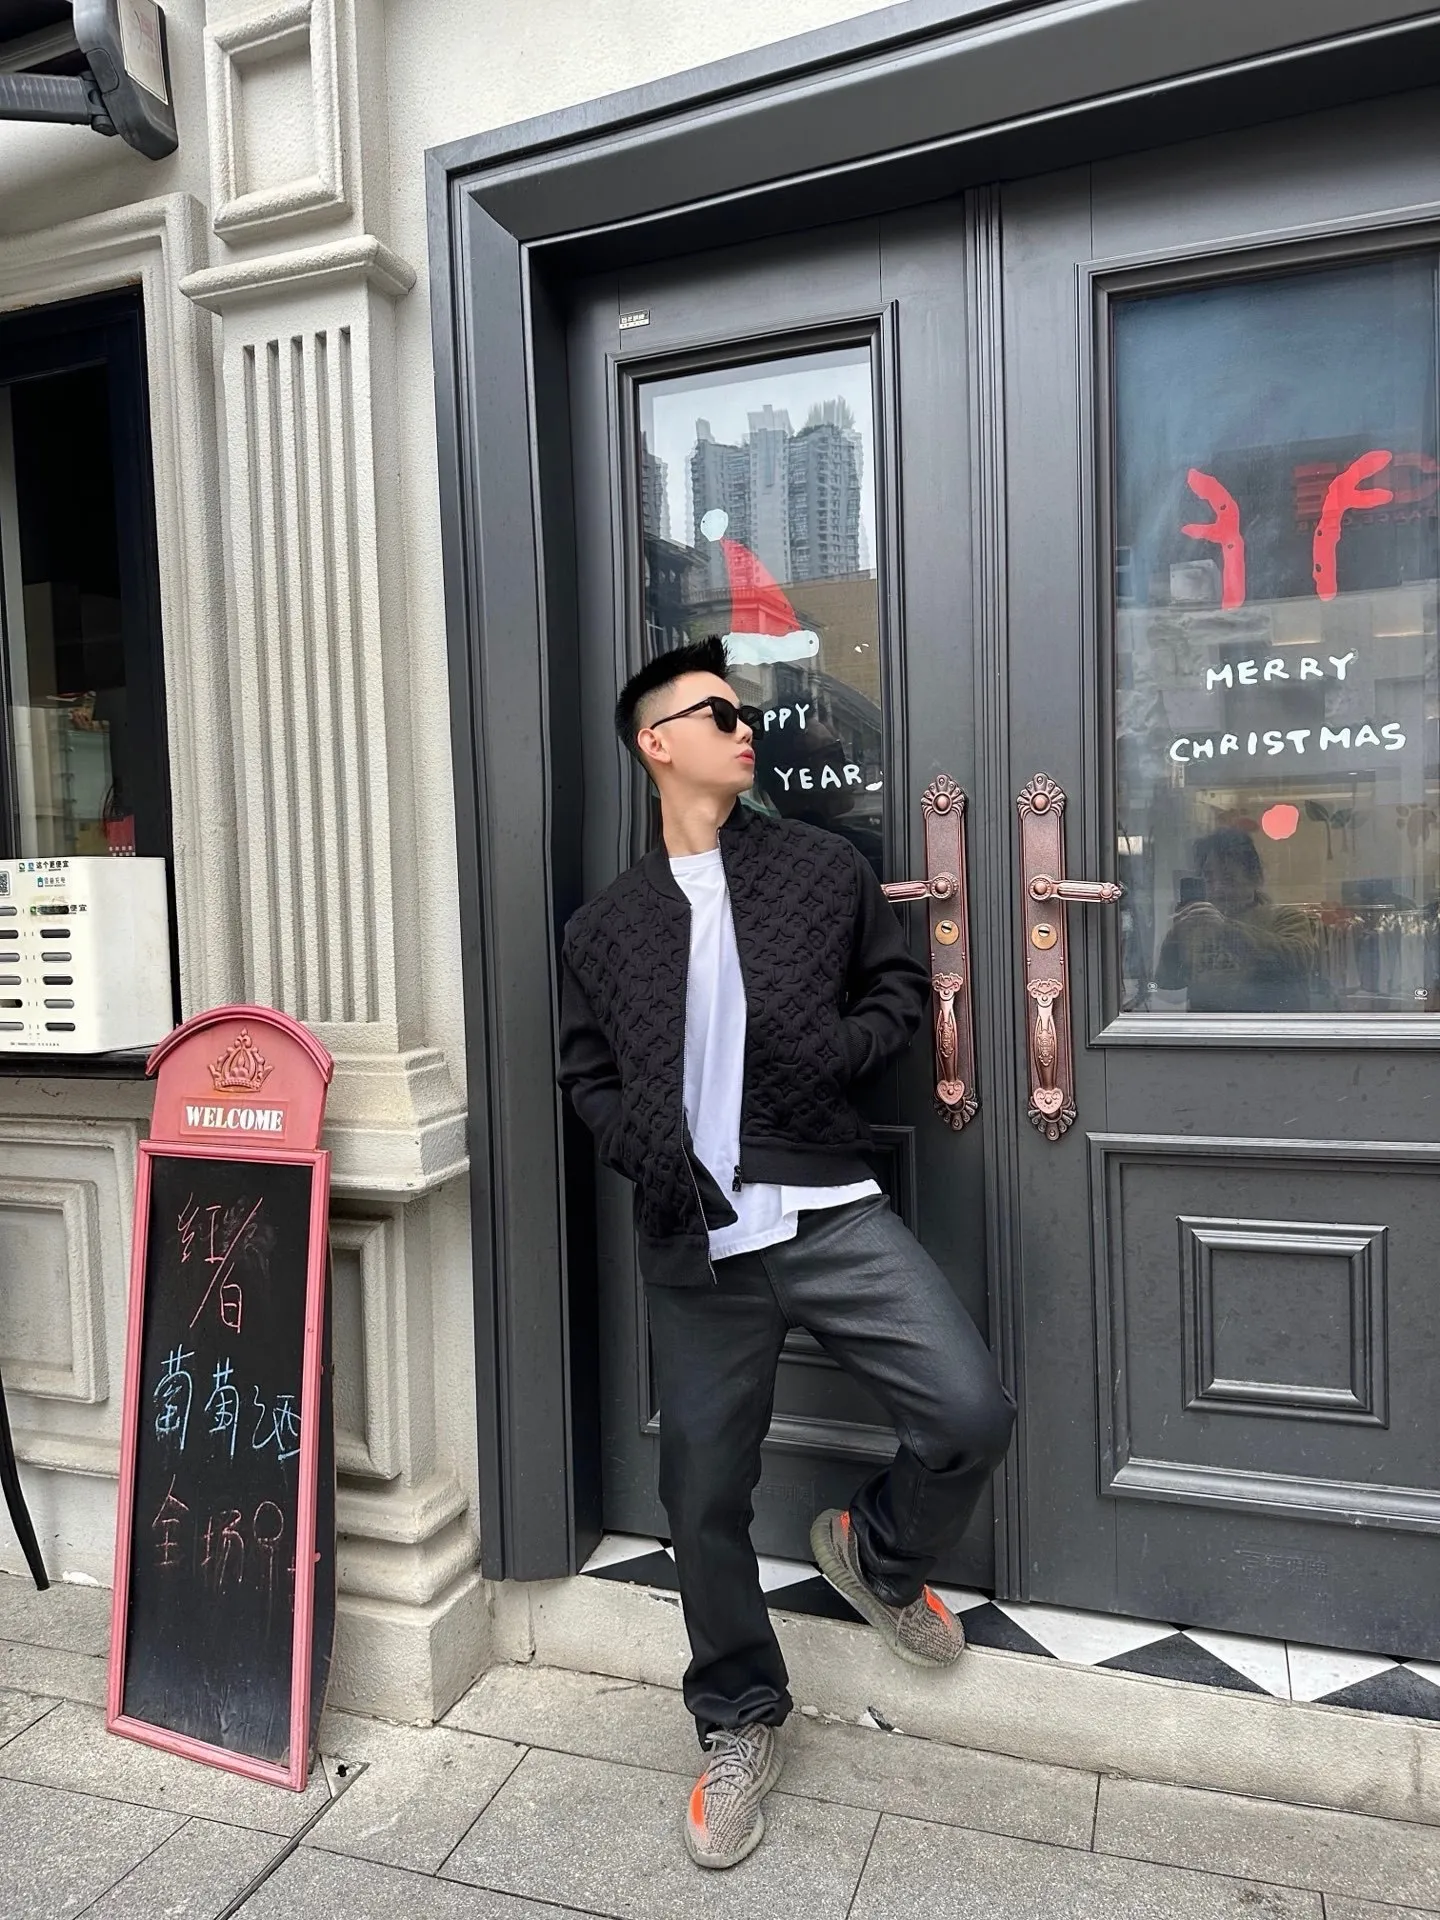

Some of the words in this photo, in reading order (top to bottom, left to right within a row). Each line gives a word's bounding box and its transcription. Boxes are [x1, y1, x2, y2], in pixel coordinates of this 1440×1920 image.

[1206, 652, 1354, 690] MERRY
[763, 703, 810, 731] PPY
[1169, 722, 1407, 762] CHRISTMAS
[774, 764, 862, 791] YEAR
[36, 860, 69, 869] 这个更便宜
[186, 1105, 284, 1132] WELCOME
